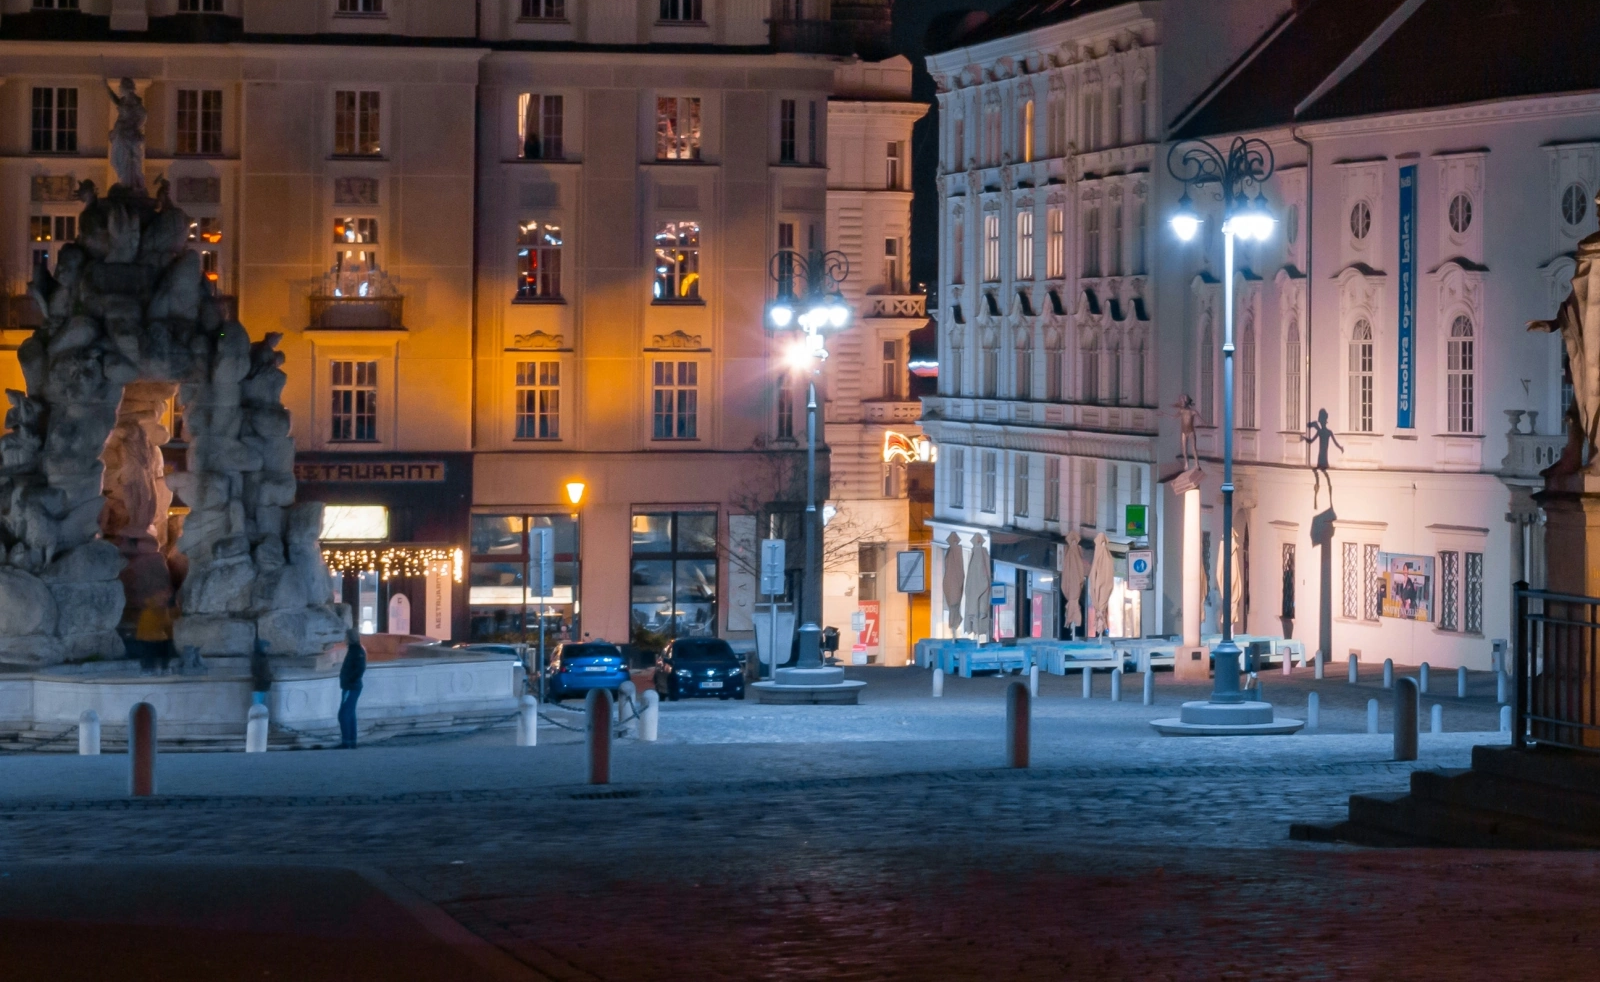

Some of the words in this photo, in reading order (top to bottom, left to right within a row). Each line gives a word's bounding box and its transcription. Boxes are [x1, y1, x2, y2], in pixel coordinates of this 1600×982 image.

[1401, 213, 1411, 263] balet
[1401, 272, 1411, 329] opera
[1400, 336, 1410, 412] činohra
